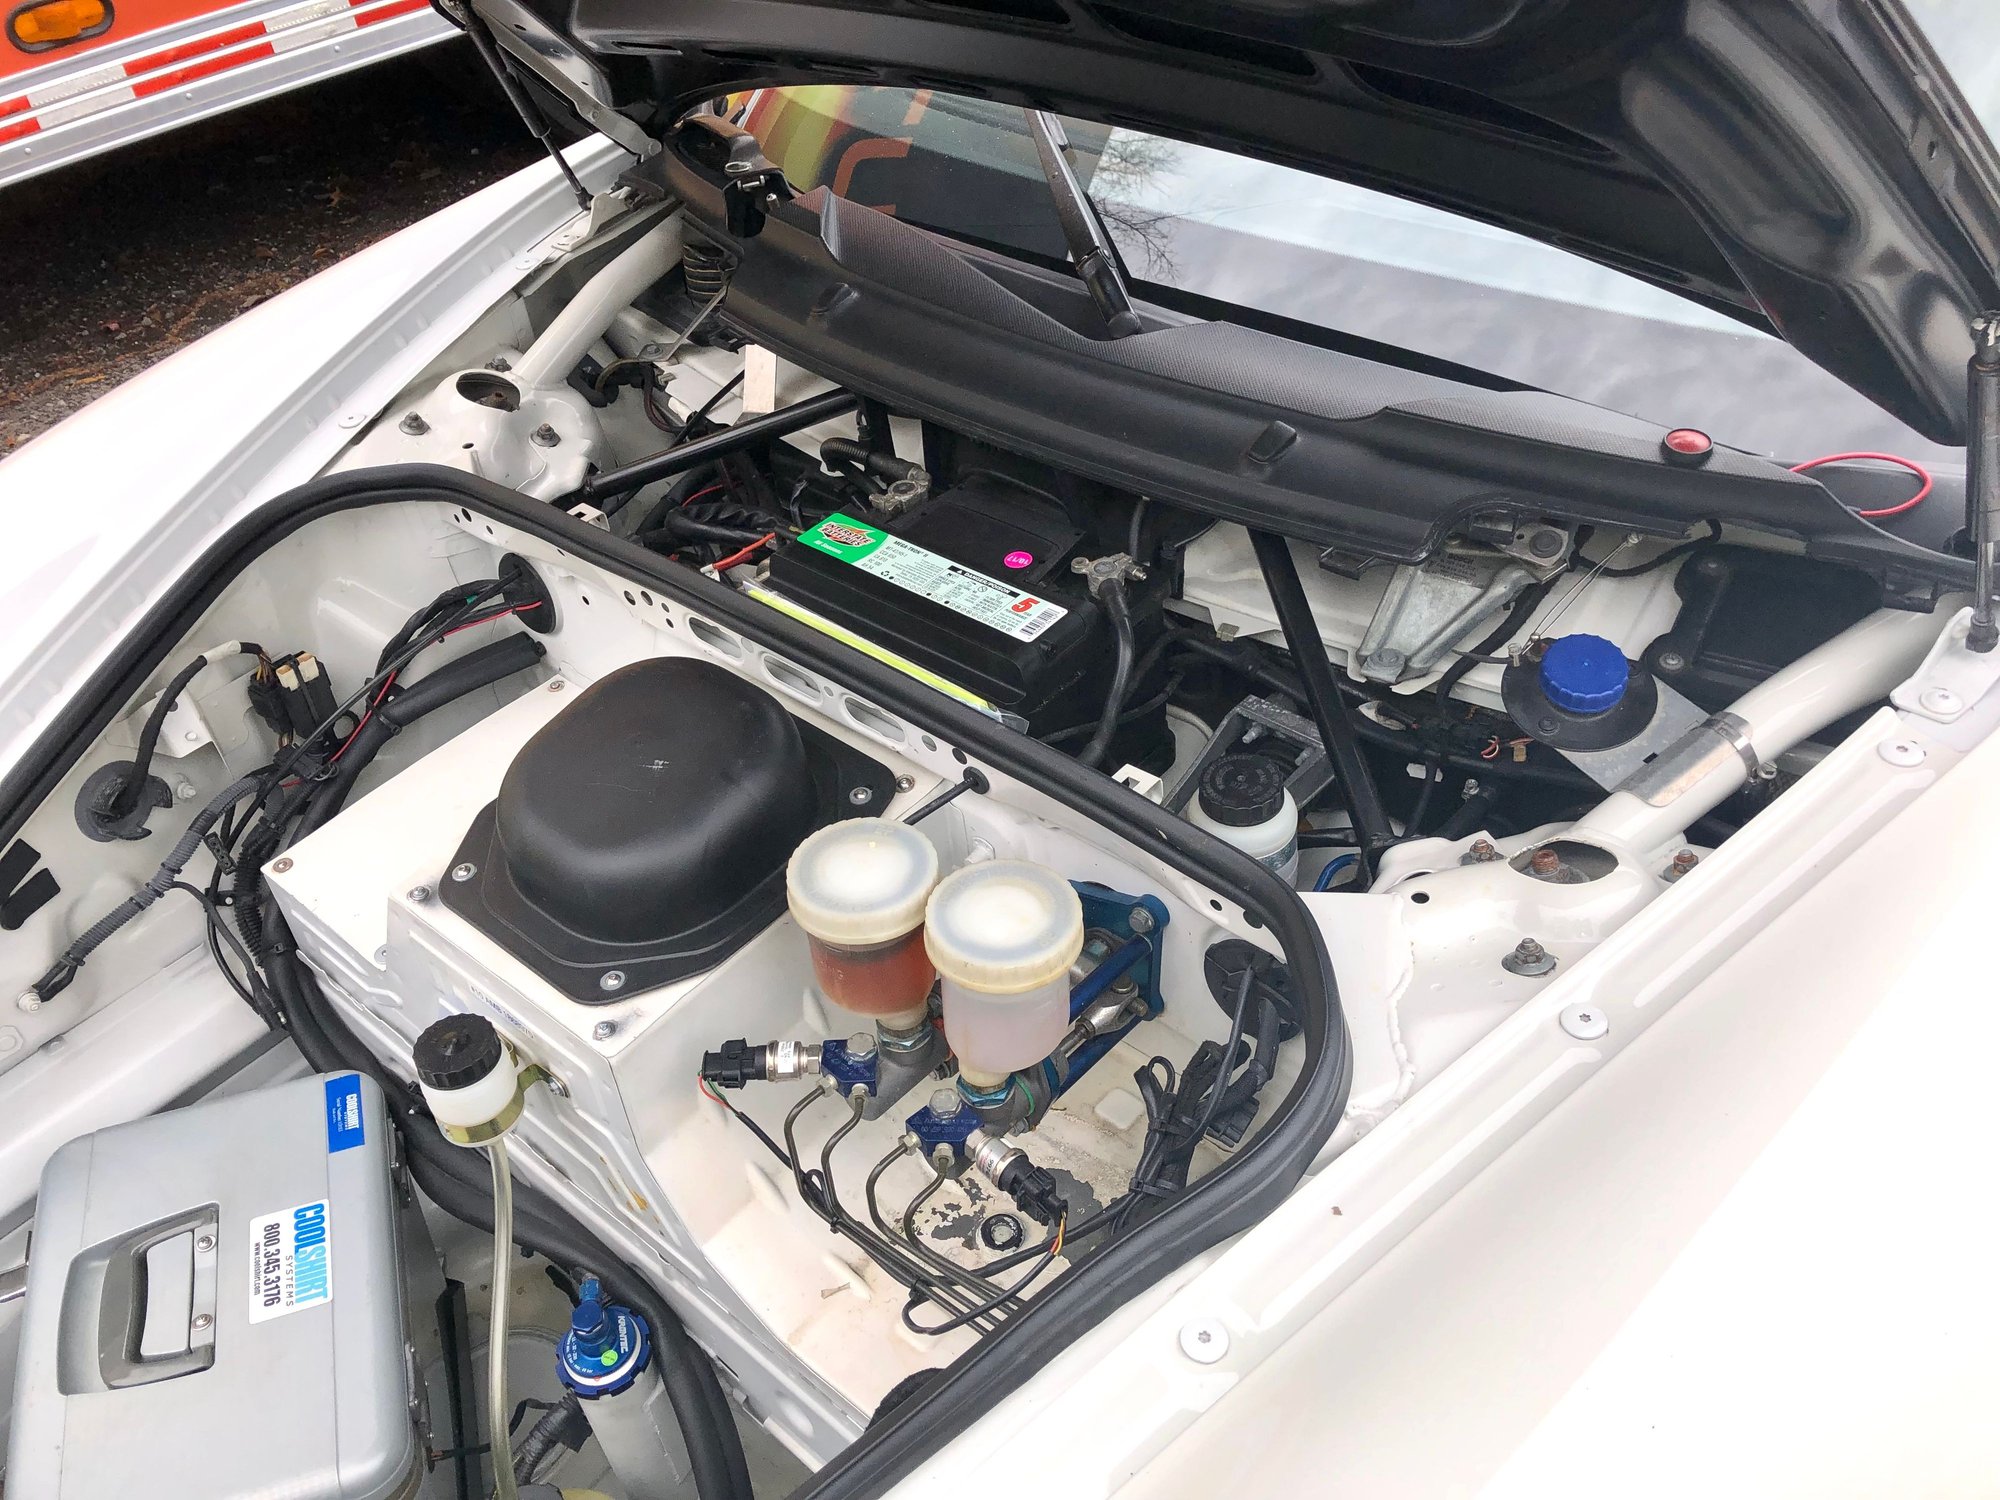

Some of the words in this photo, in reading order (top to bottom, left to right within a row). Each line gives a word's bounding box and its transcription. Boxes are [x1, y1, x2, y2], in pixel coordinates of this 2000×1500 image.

[821, 528, 861, 546] BATTERIES
[824, 523, 872, 544] INTERSTATE
[1007, 555, 1030, 565] 10/17
[964, 572, 1011, 594] DANGER/POISON
[1011, 597, 1040, 613] 5
[346, 1093, 359, 1130] COOLSHIRT
[253, 1241, 261, 1297] www.coolshirt.com
[263, 1222, 281, 1308] 800.345.3176
[293, 1203, 328, 1304] COOLSHIRT
[285, 1255, 294, 1308] SYSTEMS
[617, 1315, 629, 1354] KRONTEC
